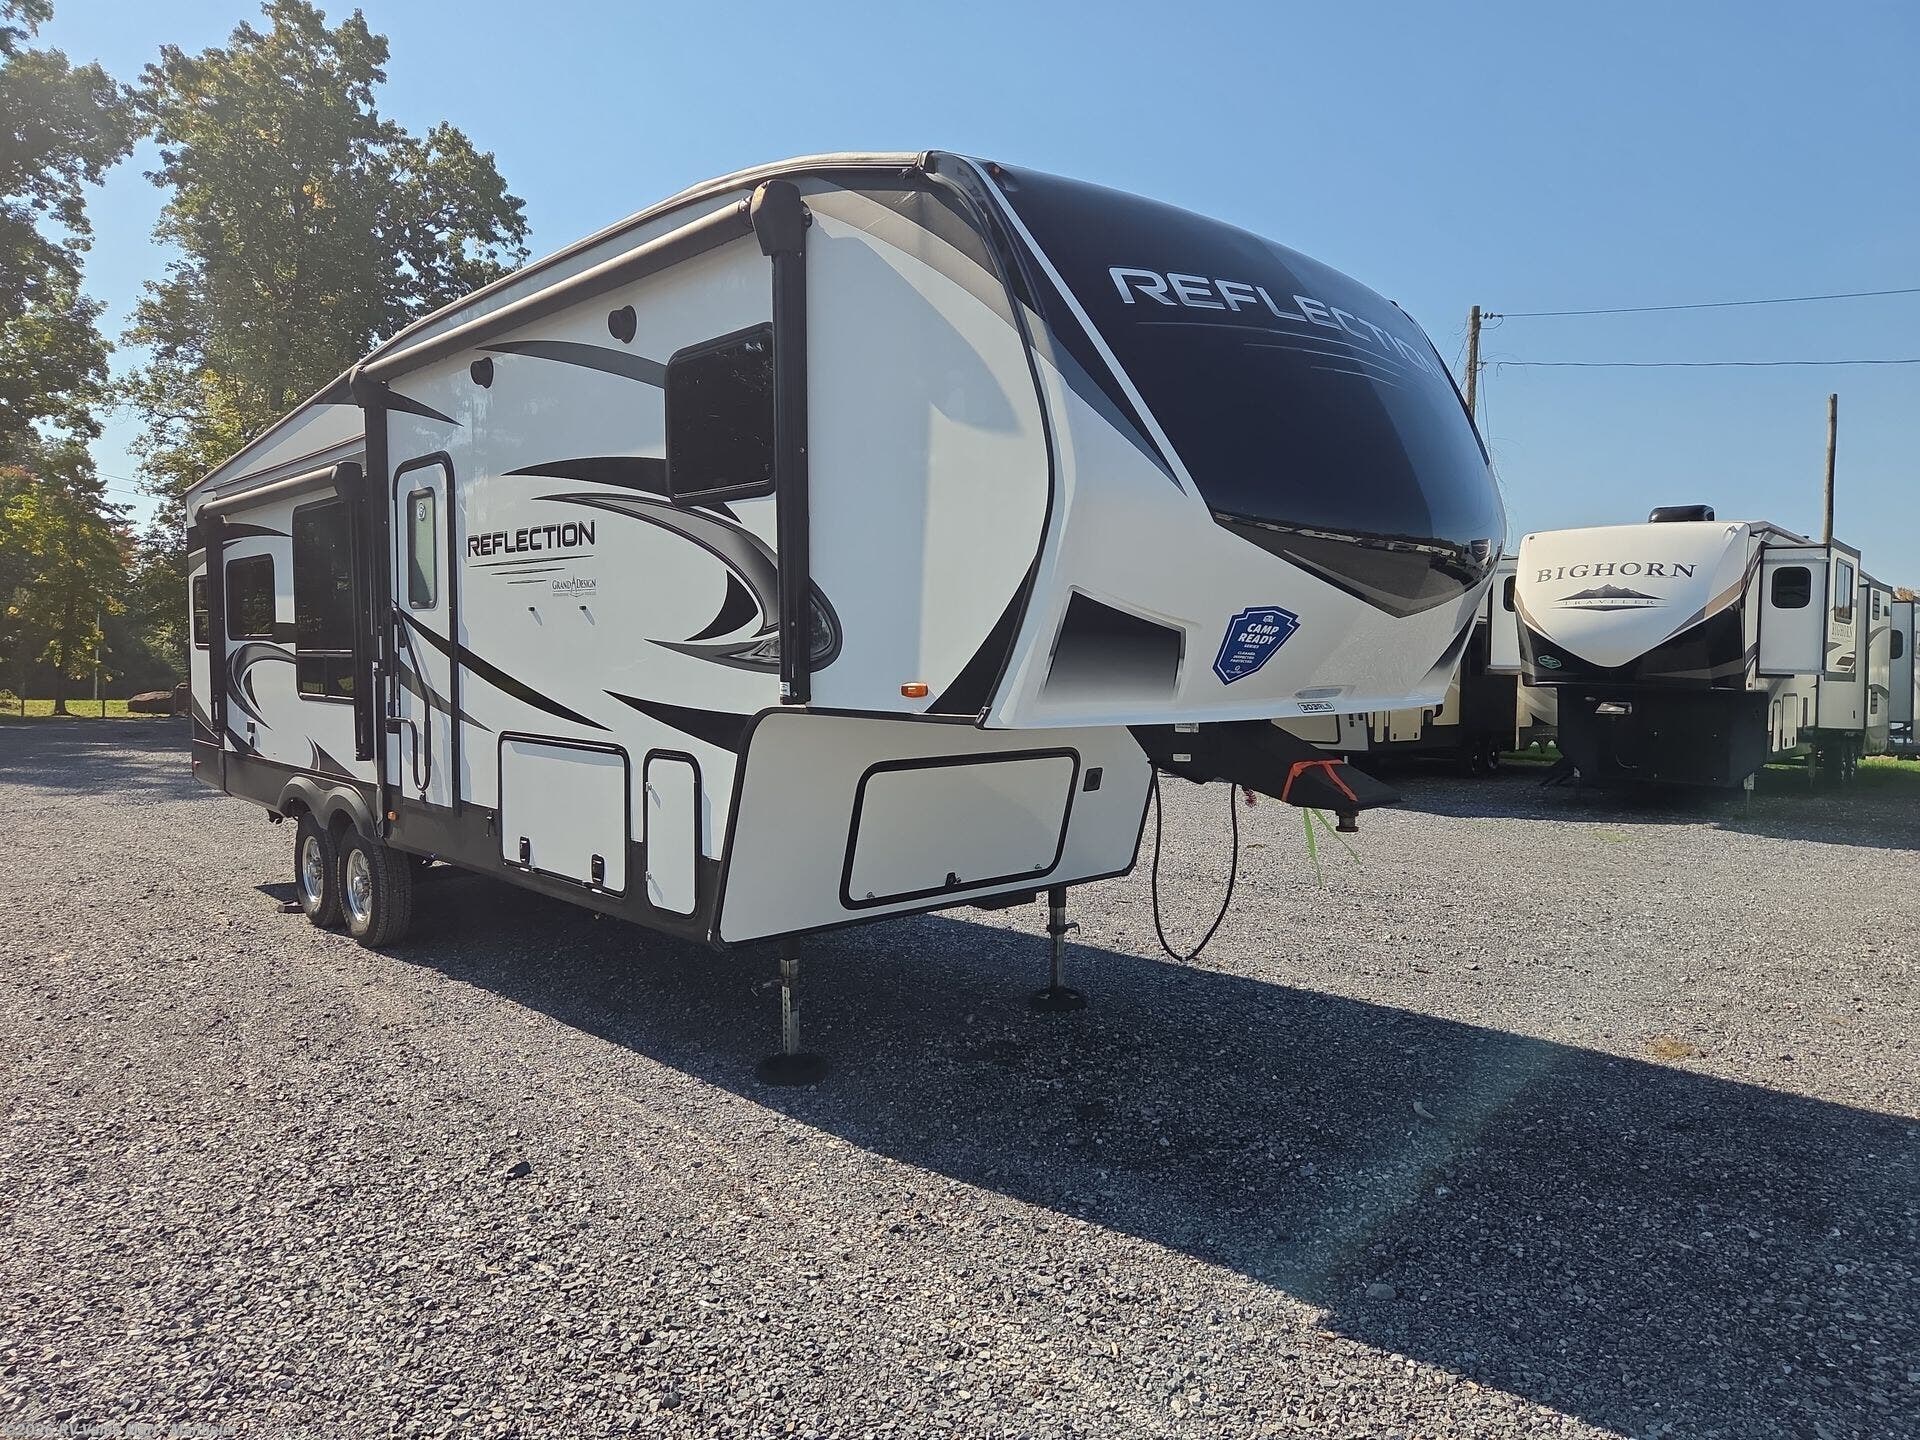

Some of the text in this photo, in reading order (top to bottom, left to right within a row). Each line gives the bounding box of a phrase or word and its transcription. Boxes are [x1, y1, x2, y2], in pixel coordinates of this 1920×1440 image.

[467, 519, 596, 557] REFLECTION
[1535, 562, 1697, 583] BIGHORN
[1247, 623, 1280, 635] CAMP
[1237, 632, 1277, 645] READY
